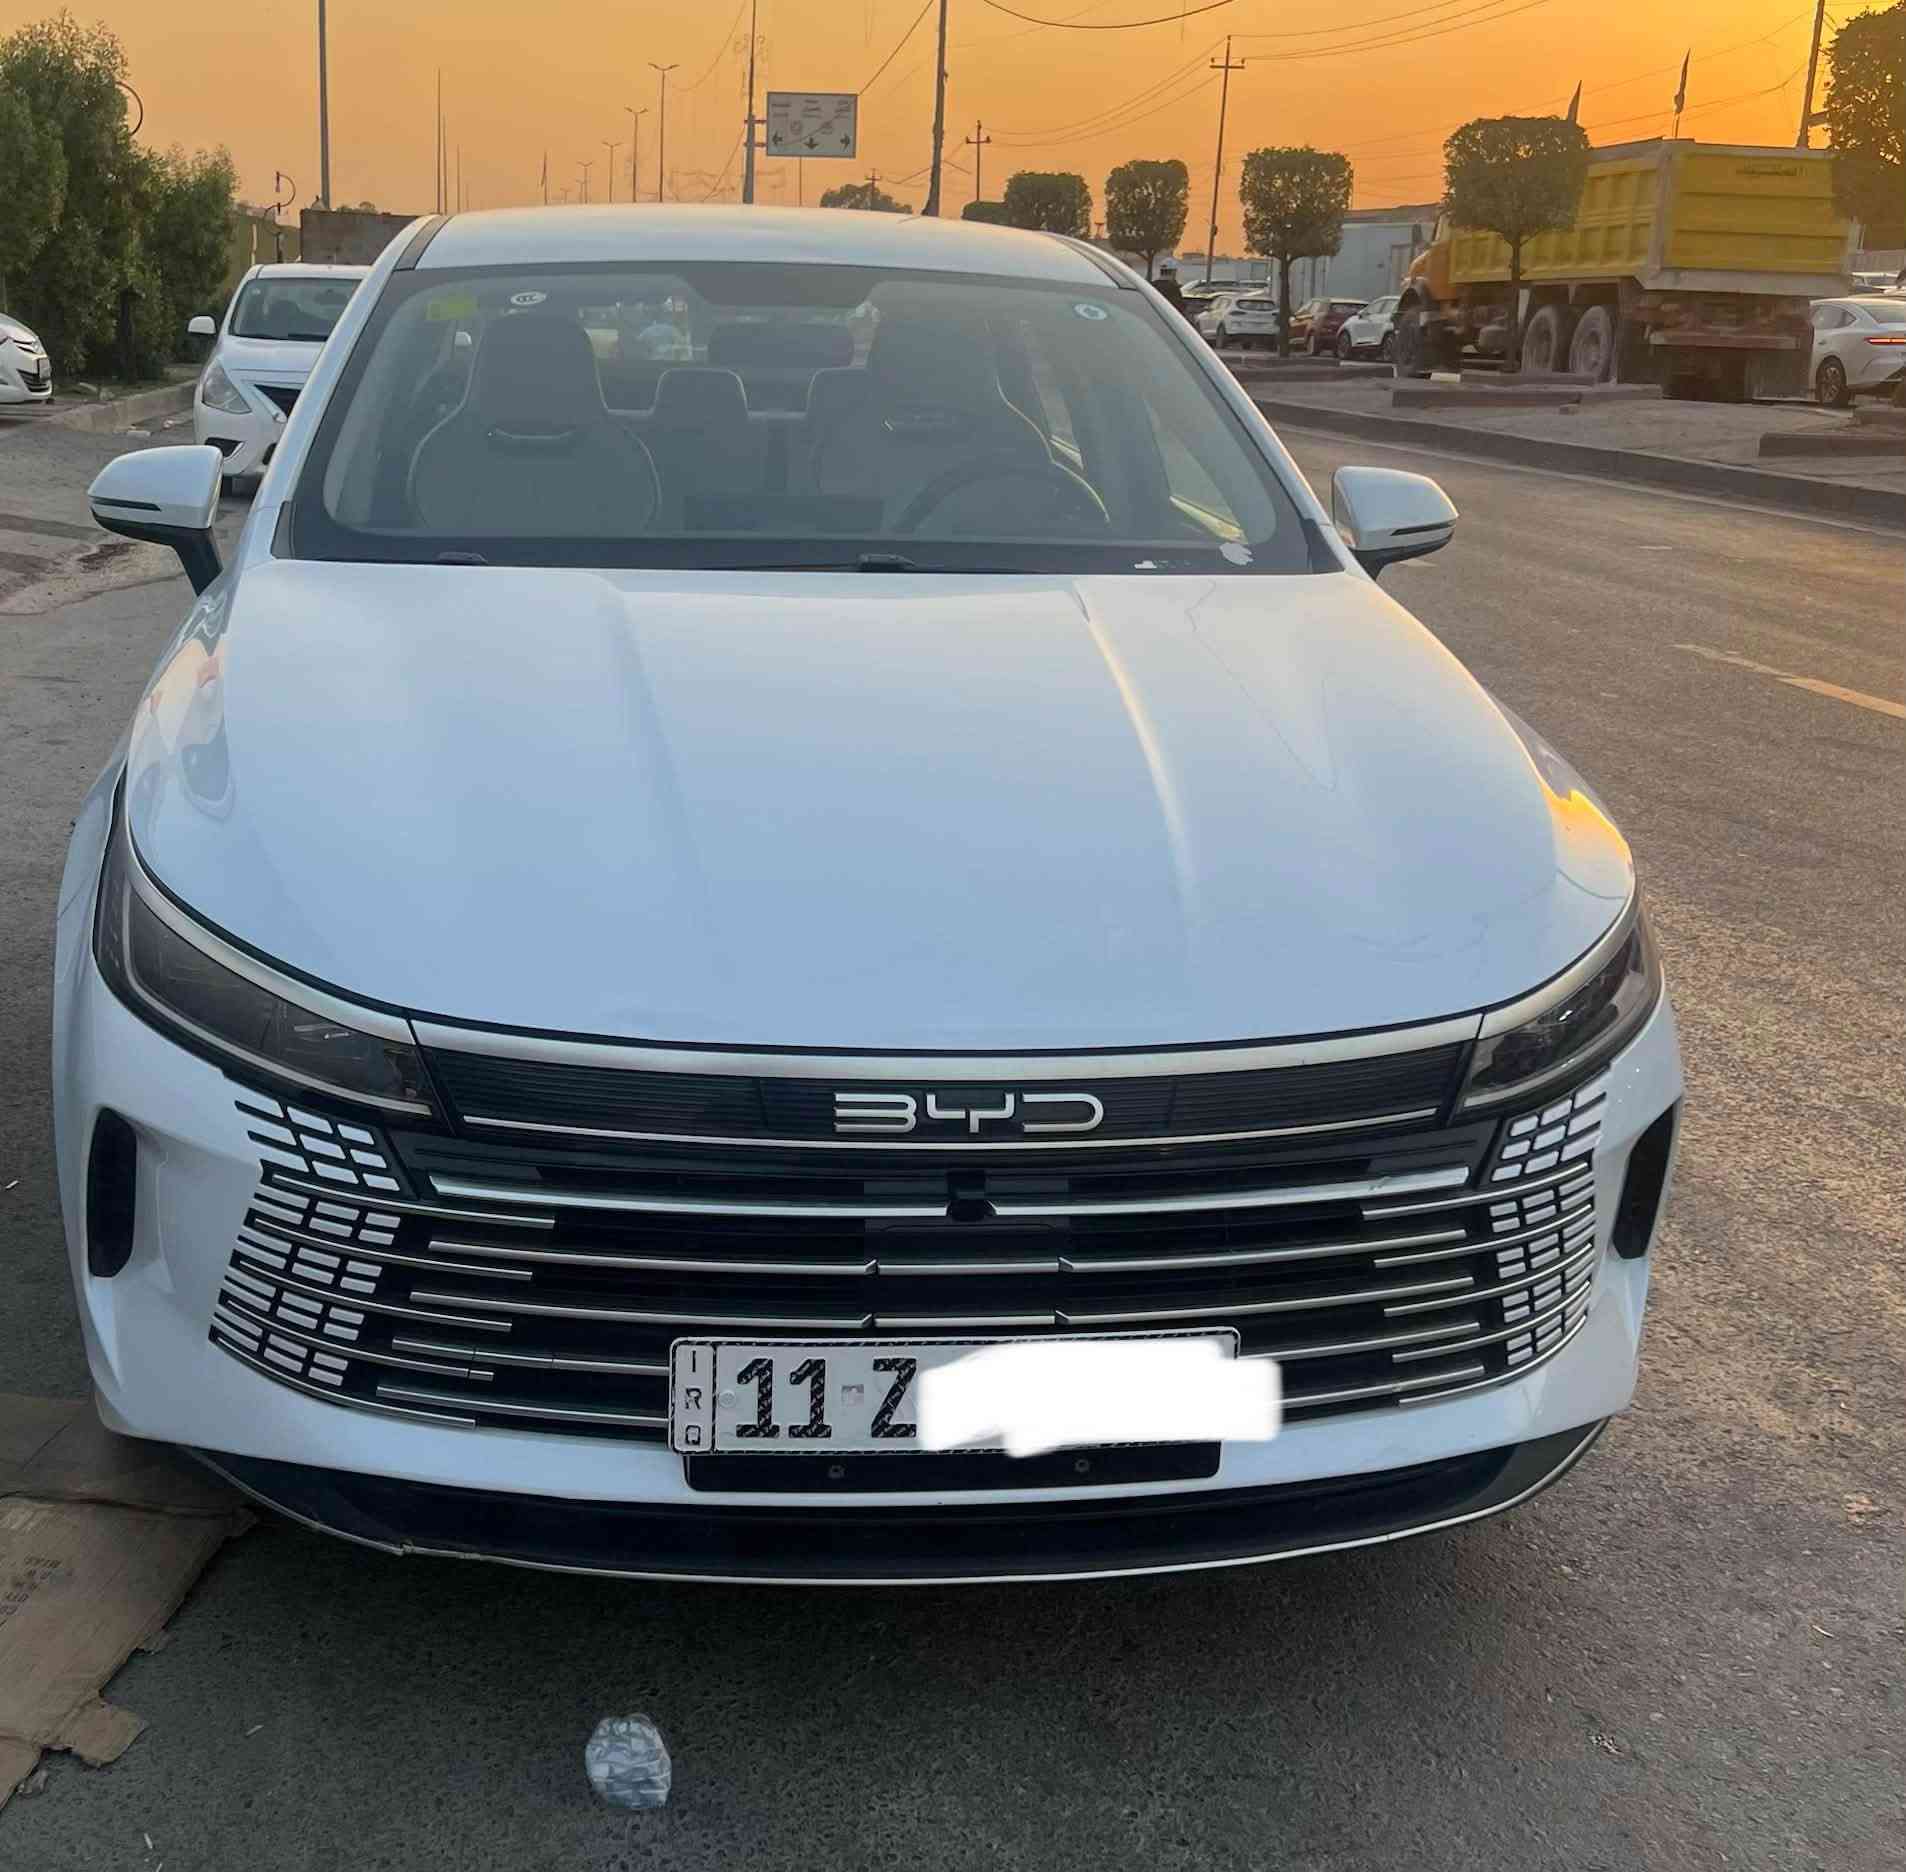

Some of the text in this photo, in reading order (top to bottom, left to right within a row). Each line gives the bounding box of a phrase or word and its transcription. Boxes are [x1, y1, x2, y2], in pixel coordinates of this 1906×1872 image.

[834, 1093, 1104, 1133] BYD
[737, 1358, 917, 1438] 11 Z
